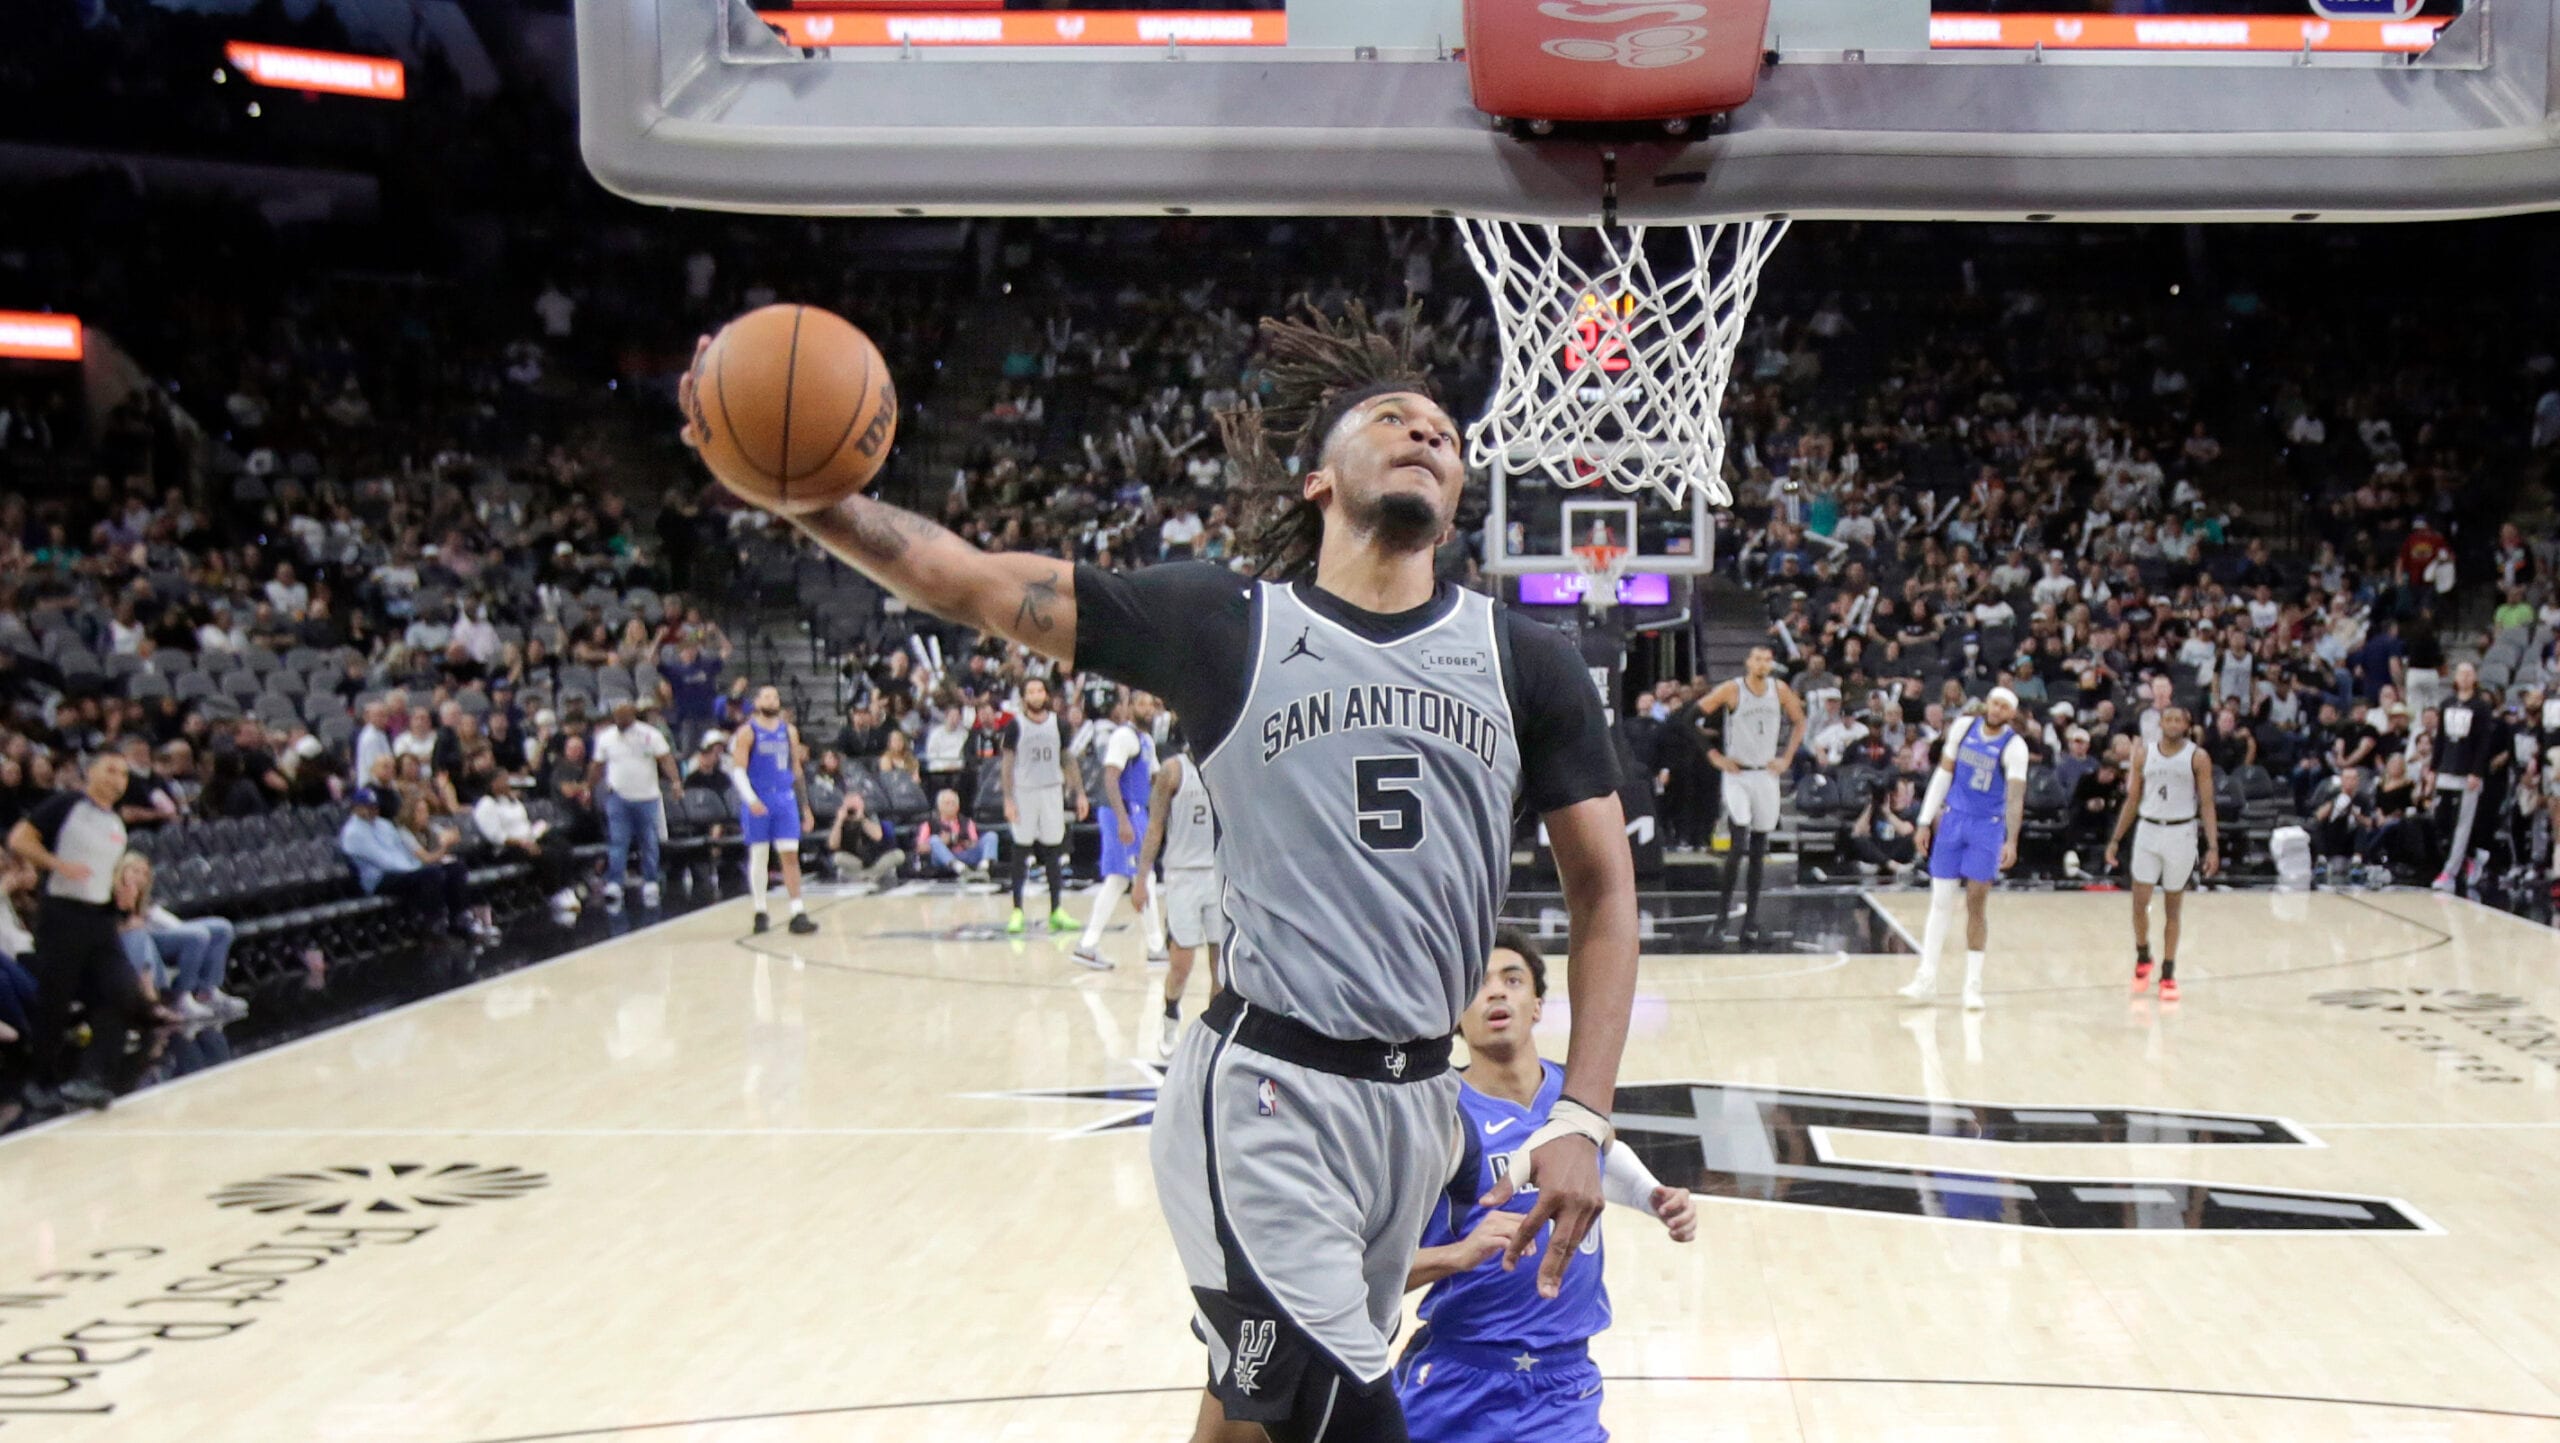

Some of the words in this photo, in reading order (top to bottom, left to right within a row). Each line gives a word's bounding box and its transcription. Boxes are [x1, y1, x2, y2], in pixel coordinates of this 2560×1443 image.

[1429, 655, 1478, 667] LEDGER
[1261, 688, 1333, 766] SAN
[1340, 684, 1498, 773] ANTONIO
[1032, 746, 1052, 762] 30
[2158, 785, 2168, 801] 4
[1353, 754, 1426, 852] 5
[1193, 804, 1206, 825] 2
